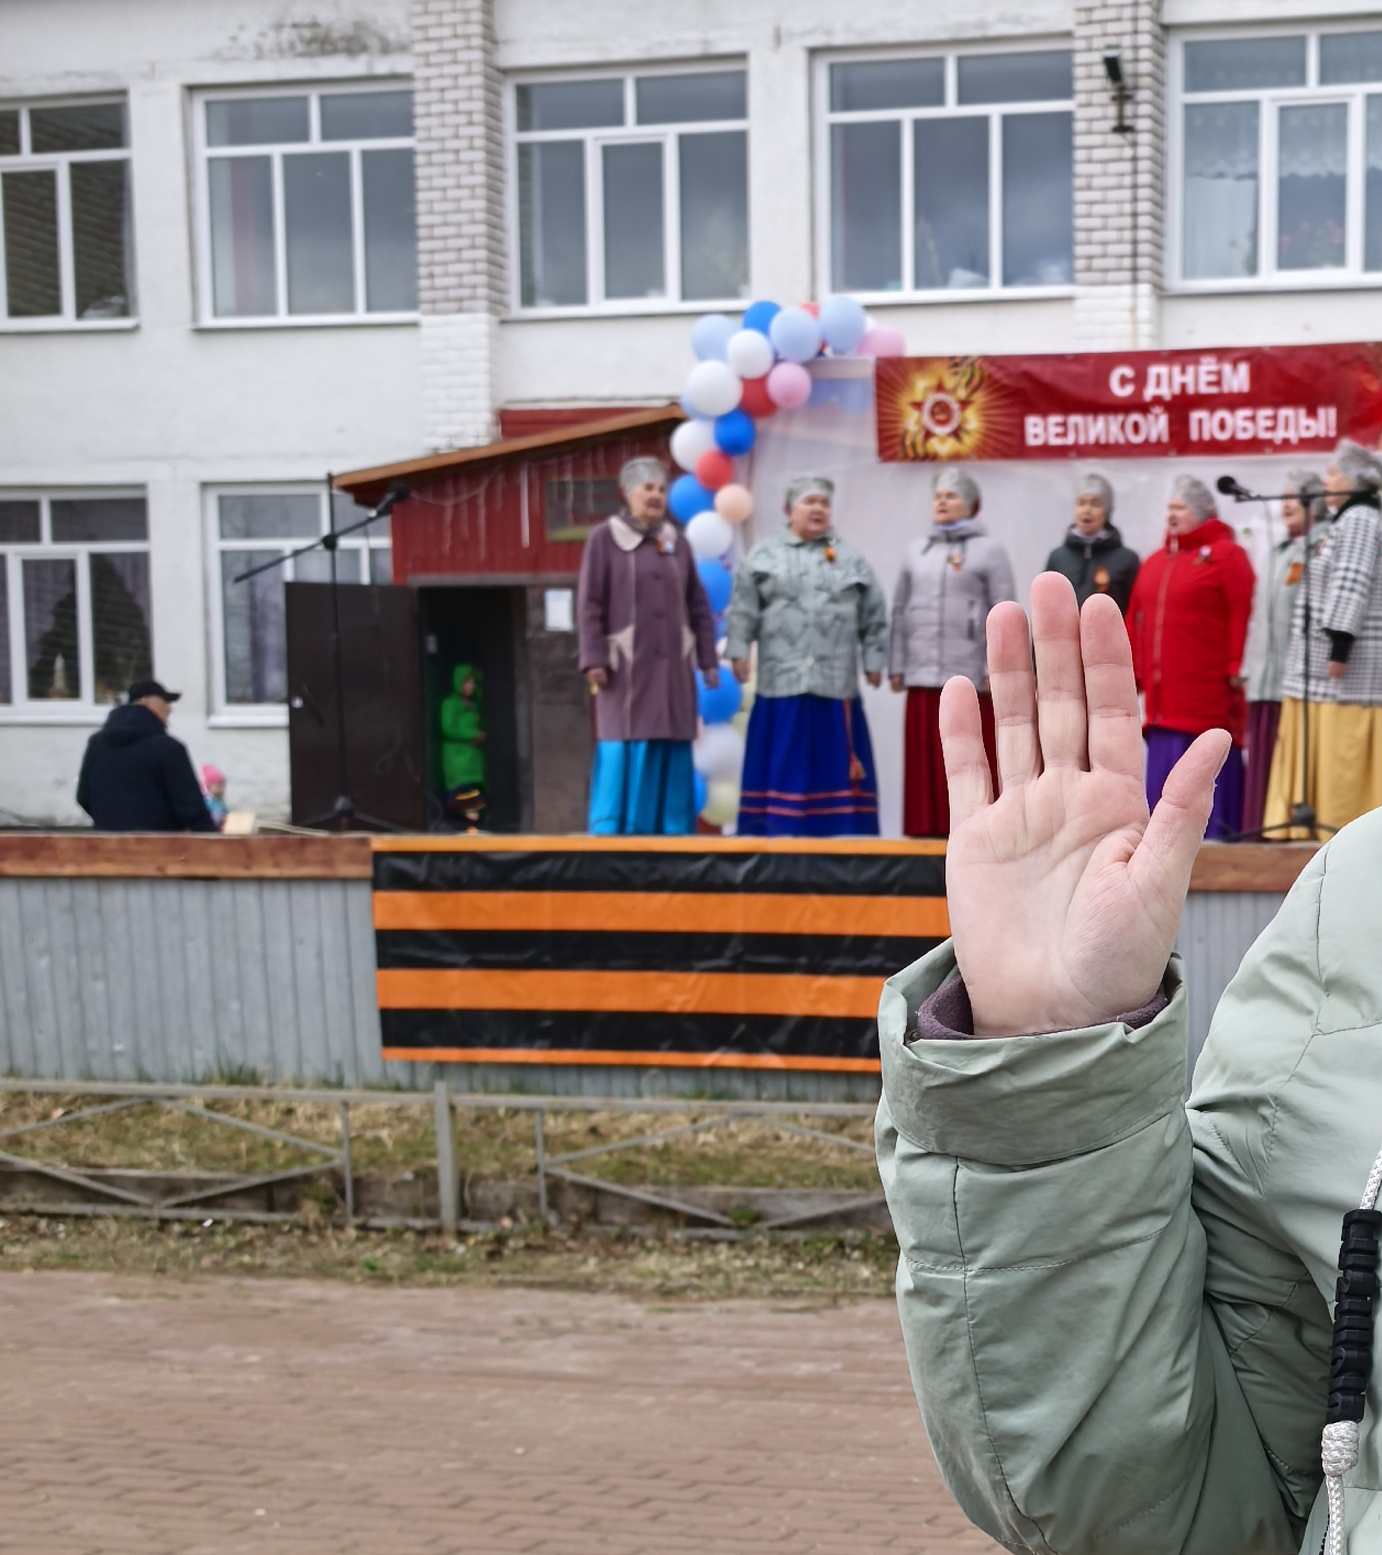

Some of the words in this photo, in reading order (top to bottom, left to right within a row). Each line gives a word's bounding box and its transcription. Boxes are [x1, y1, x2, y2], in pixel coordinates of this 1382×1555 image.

[1109, 364, 1136, 397] С
[1143, 356, 1250, 401] ДНЁМ
[1024, 405, 1169, 446] ВЕЛИКОЙ
[1189, 406, 1337, 444] ПОБЕДЫ!
